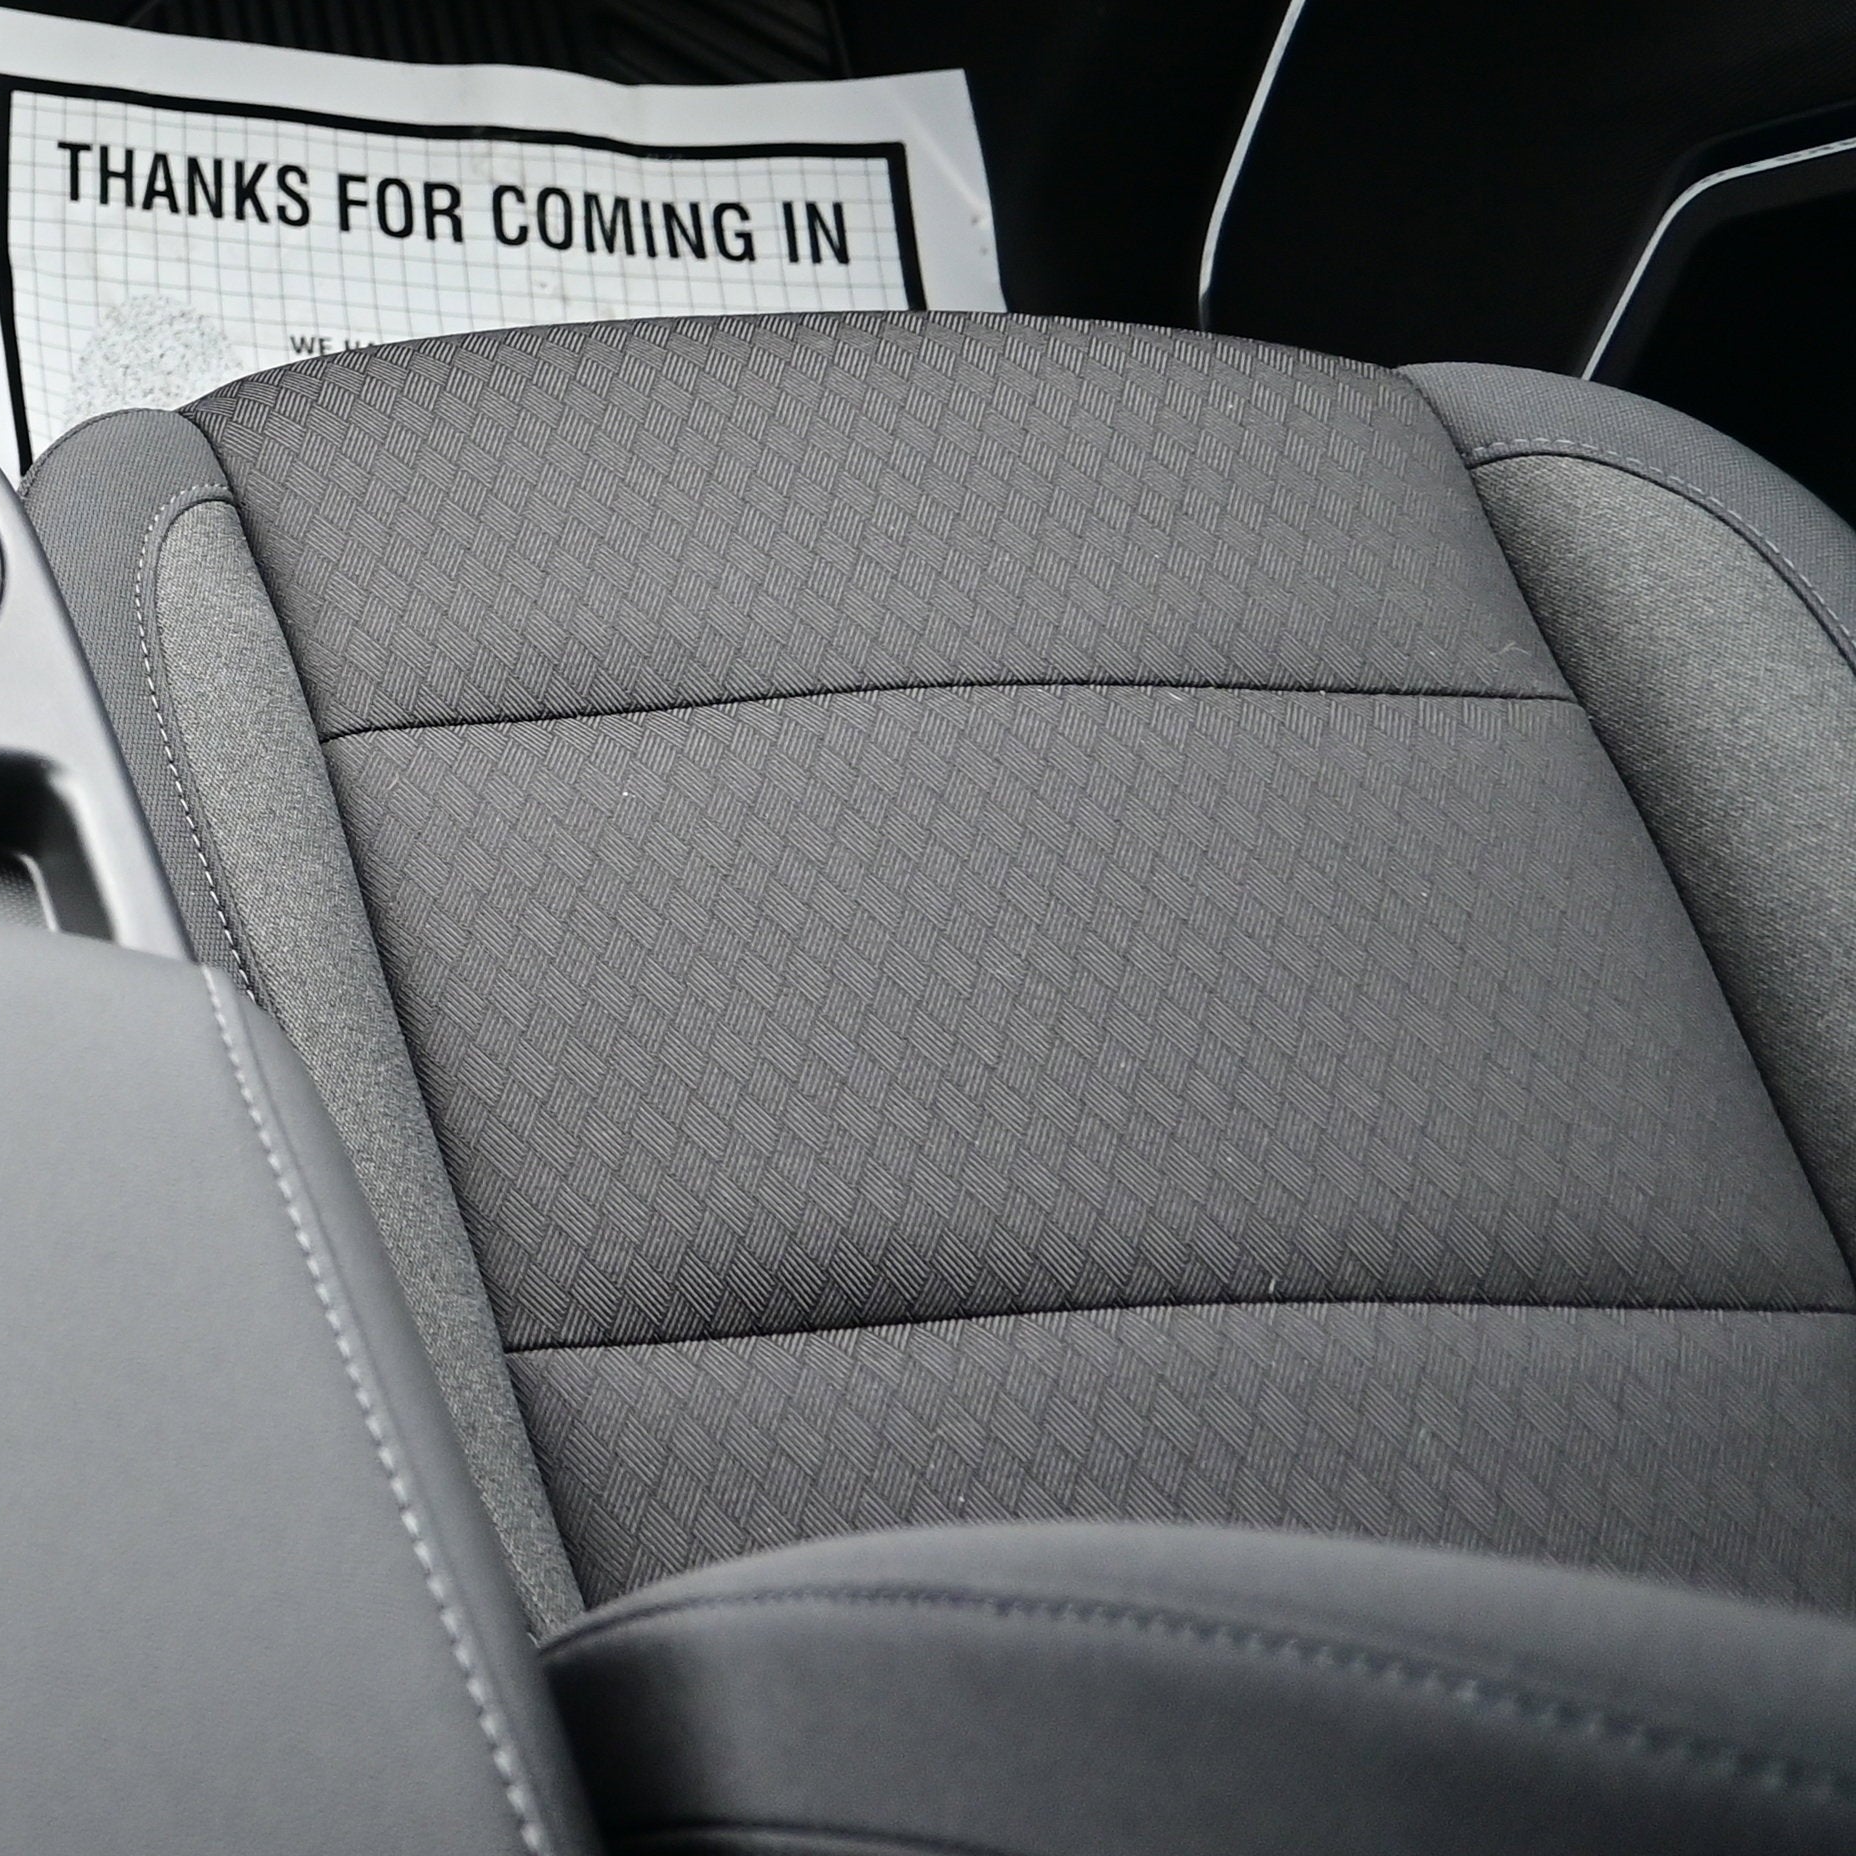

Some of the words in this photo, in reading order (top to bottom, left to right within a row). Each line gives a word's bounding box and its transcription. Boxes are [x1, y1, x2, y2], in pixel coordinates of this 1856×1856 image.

[57, 139, 311, 231] THANKS
[336, 171, 466, 245] FOR
[491, 181, 757, 267] COMING
[782, 198, 853, 269] IN
